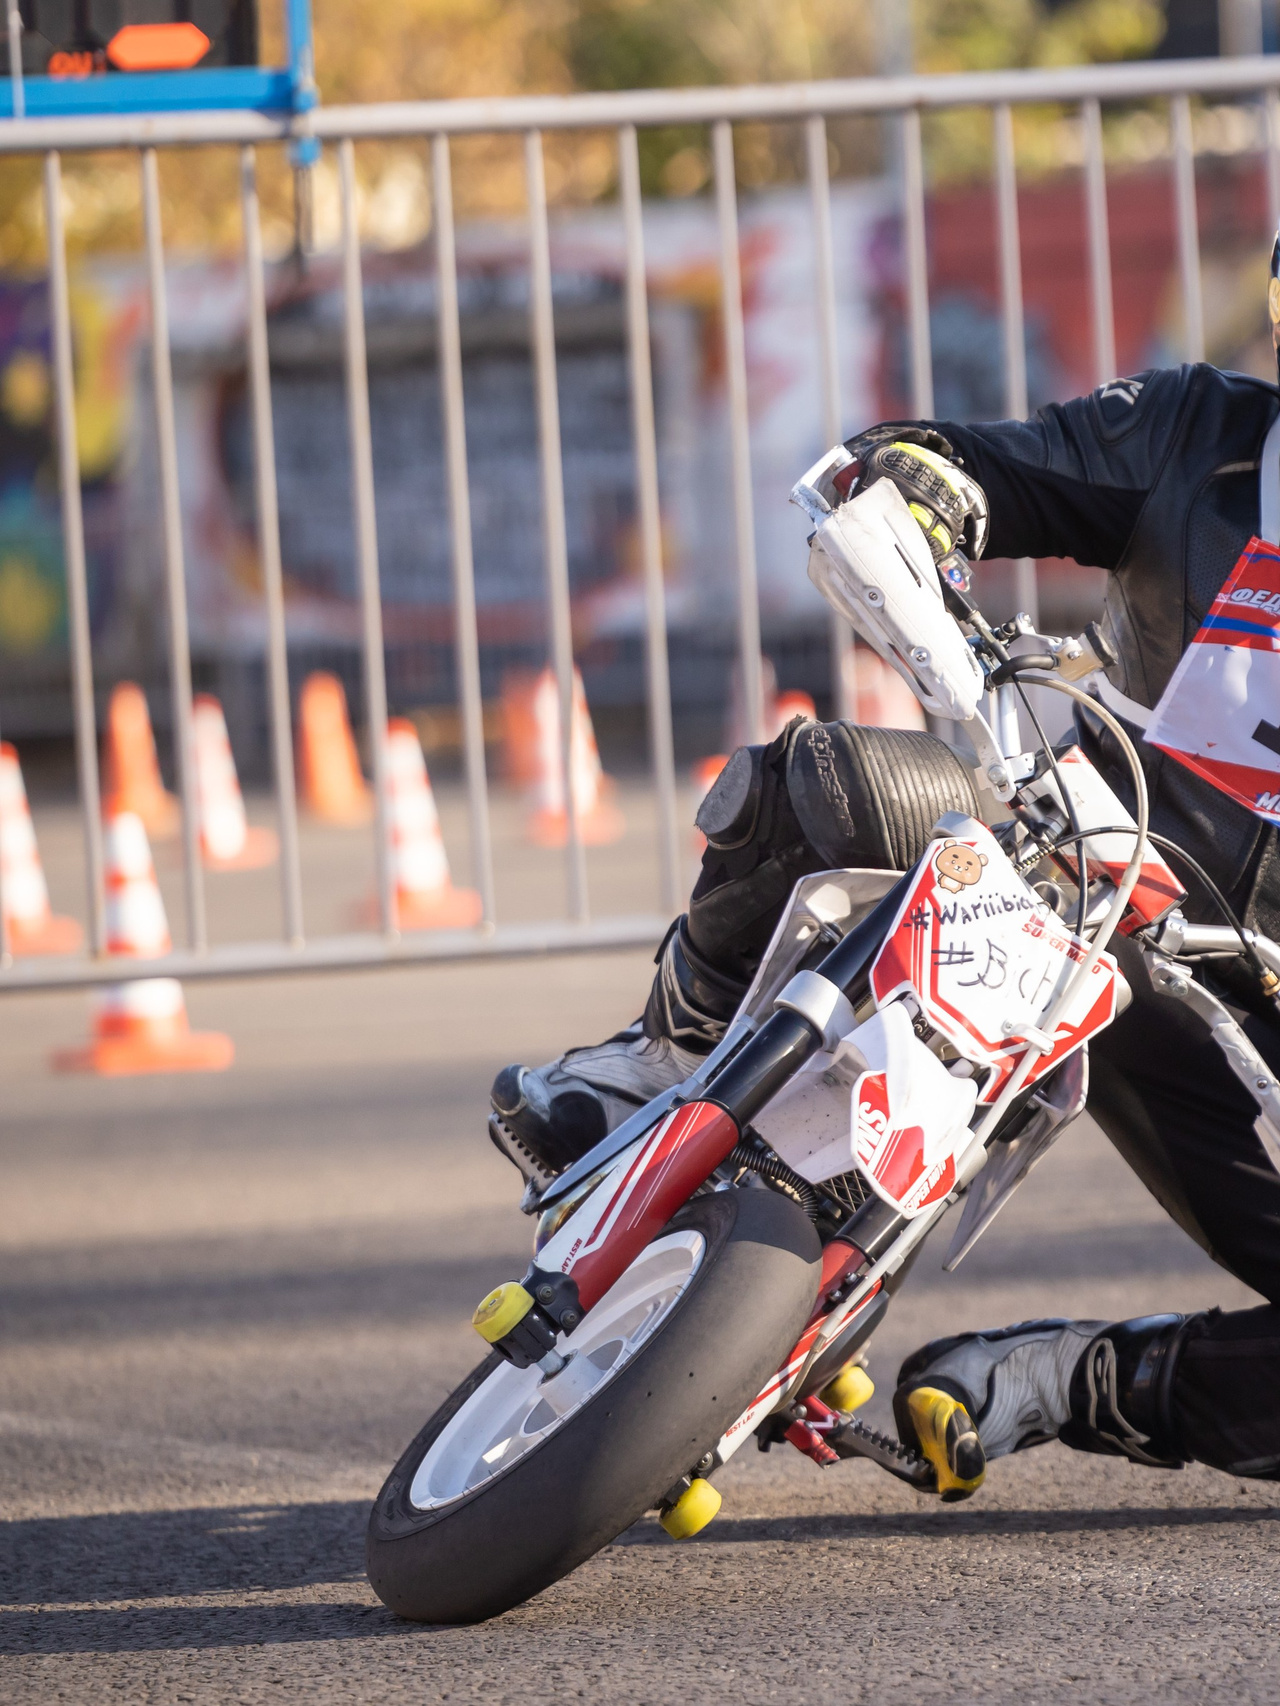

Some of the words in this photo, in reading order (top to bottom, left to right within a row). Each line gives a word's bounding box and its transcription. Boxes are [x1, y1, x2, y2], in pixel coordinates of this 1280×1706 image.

[1065, 946, 1101, 975] MOO
[569, 1238, 582, 1258] BEST
[561, 1257, 571, 1272] LAP
